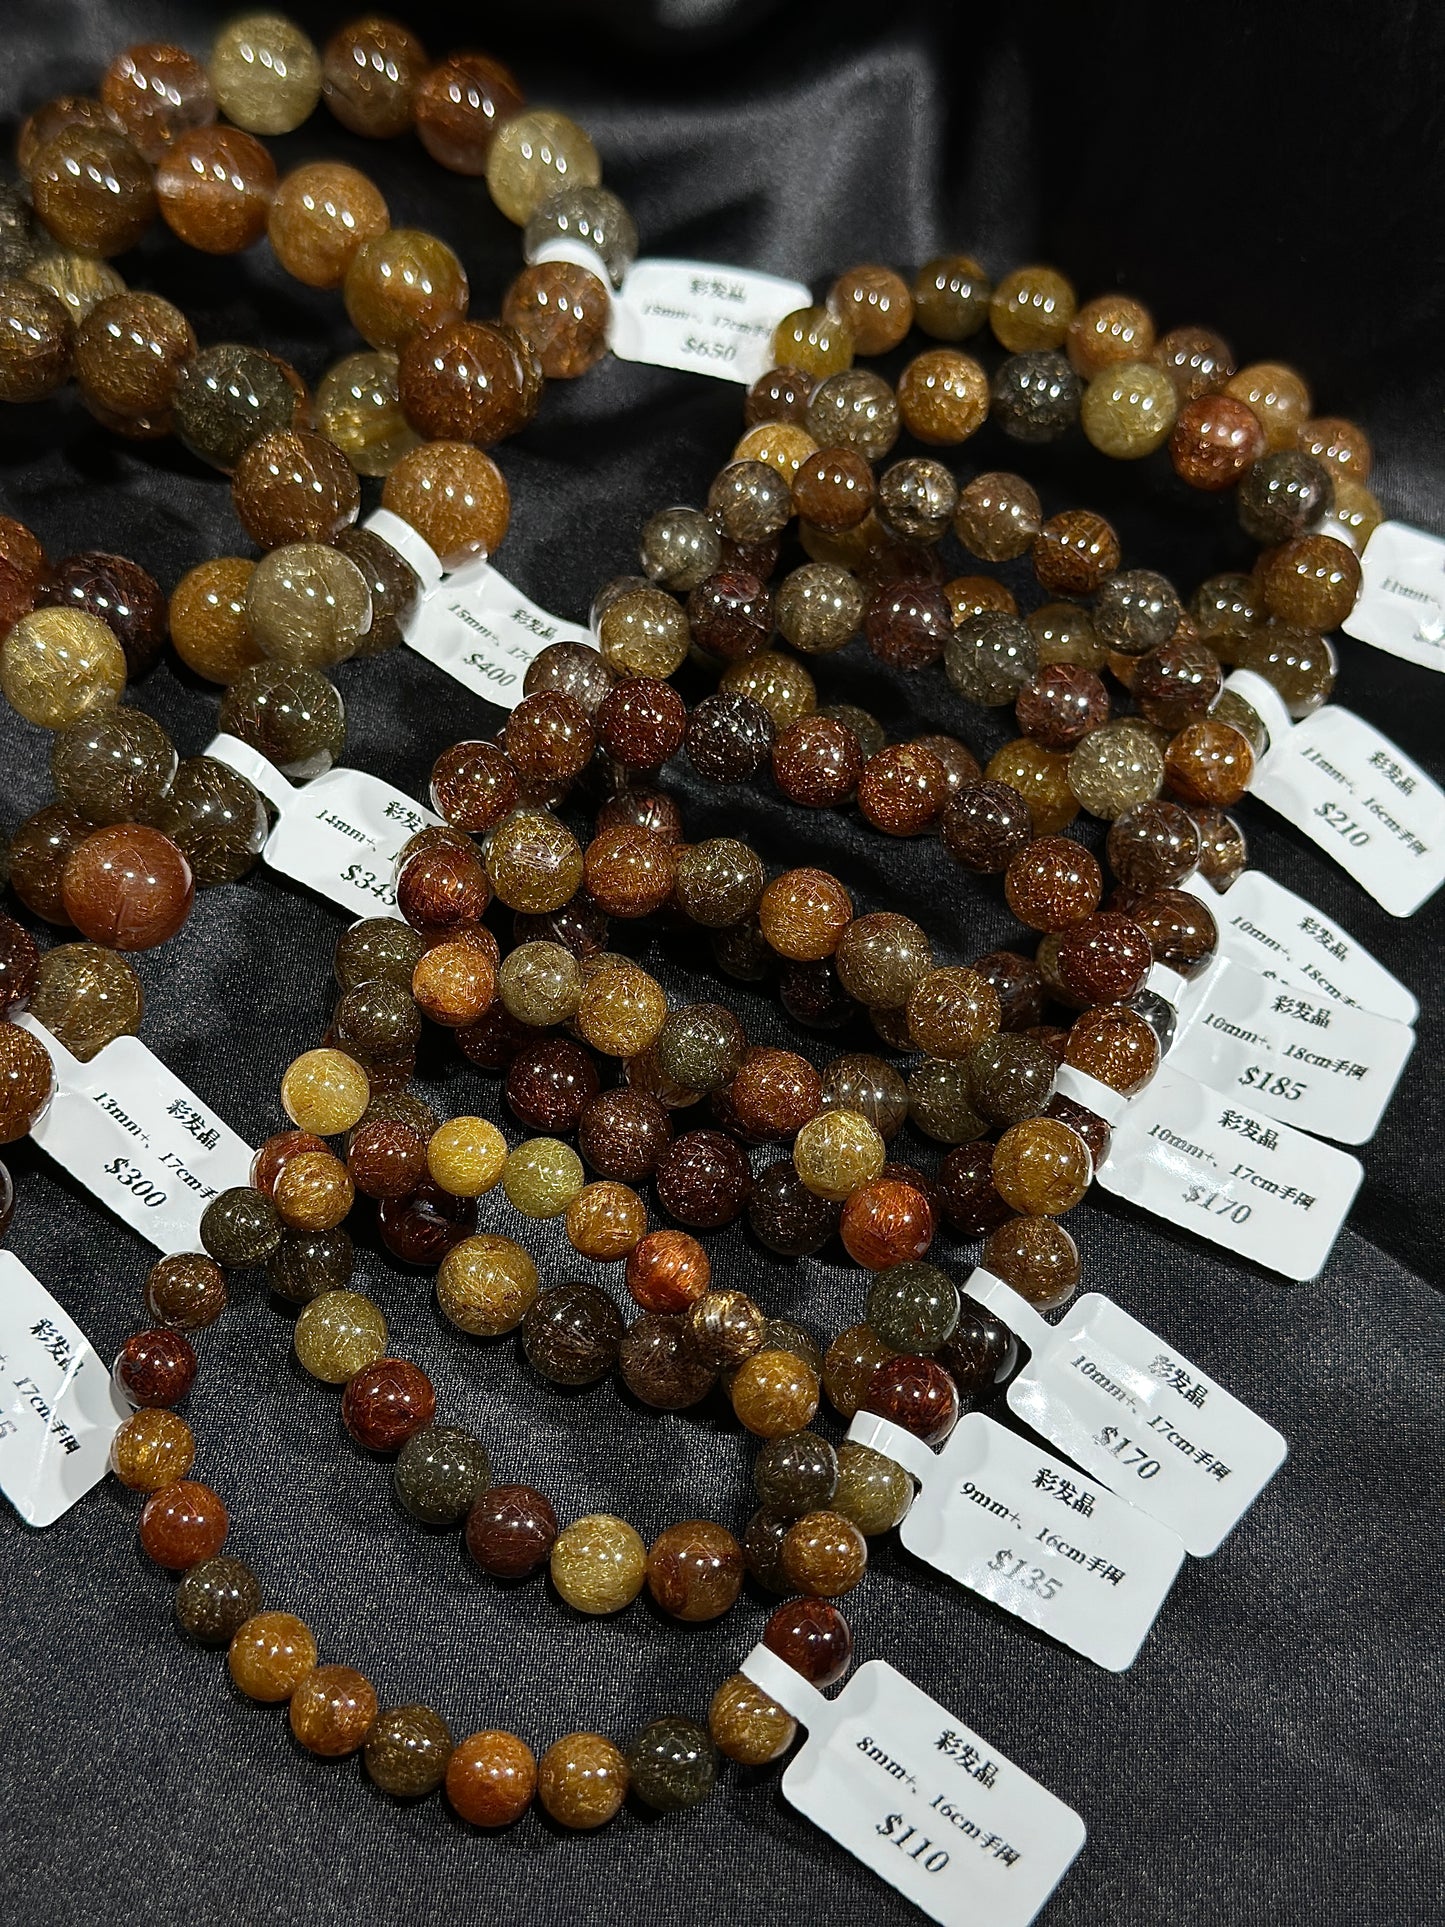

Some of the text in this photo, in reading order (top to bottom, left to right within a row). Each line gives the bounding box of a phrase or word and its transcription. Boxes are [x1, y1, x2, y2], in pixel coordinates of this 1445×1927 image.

[463, 652, 517, 687] $400
[383, 801, 431, 833] 彩发
[1313, 800, 1370, 847] $210
[1297, 916, 1349, 962] 彩发晶
[1271, 995, 1332, 1029] 彩发晶
[1238, 1065, 1308, 1101] $185
[166, 1098, 221, 1150] 彩发晶
[1218, 1109, 1280, 1151] 彩发晶
[104, 1157, 168, 1207] $300
[1182, 1184, 1253, 1224] $170
[1148, 1354, 1208, 1410] 彩发晶
[1092, 1425, 1162, 1480] $170
[1031, 1467, 1097, 1518] 彩发晶
[987, 1549, 1064, 1600] $135
[933, 1728, 999, 1790] 彩发晶
[875, 1812, 951, 1873] $110
